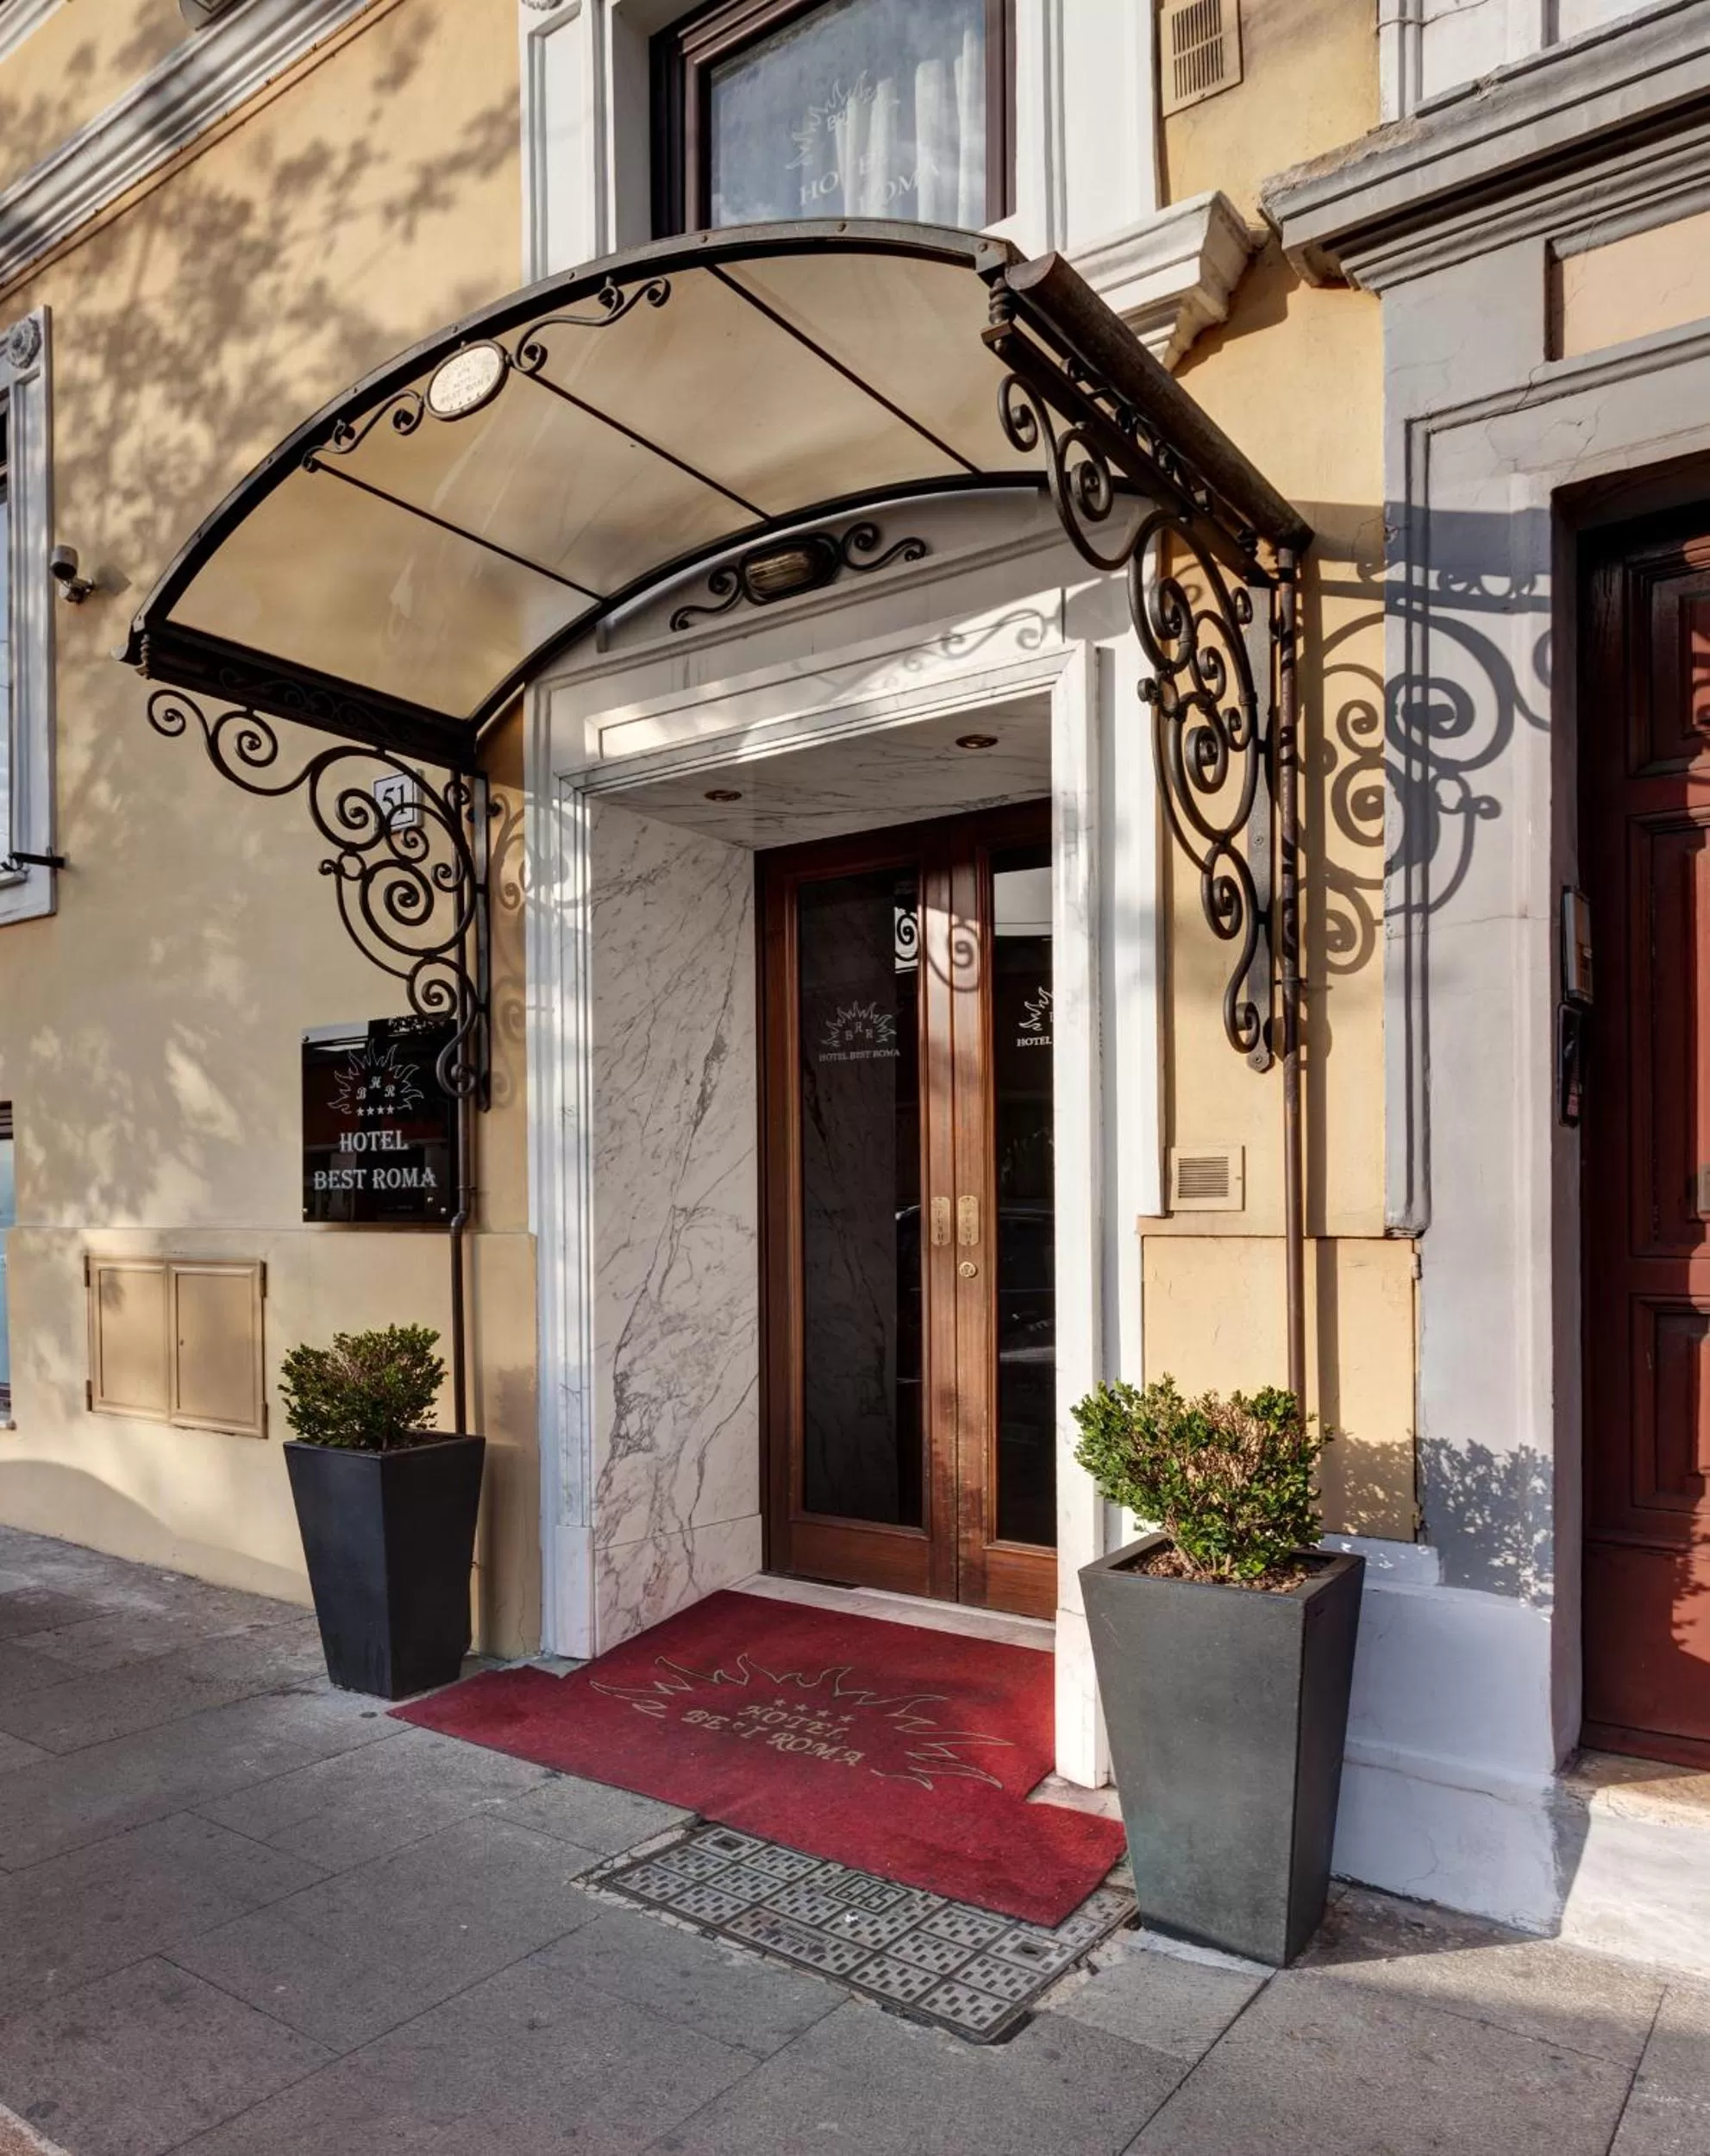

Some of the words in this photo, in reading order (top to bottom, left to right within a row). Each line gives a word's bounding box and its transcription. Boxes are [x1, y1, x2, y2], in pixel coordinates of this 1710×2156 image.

[382, 784, 407, 815] 51
[1016, 1036, 1053, 1047] HOTEL
[819, 1051, 849, 1062] HOTEL
[340, 1130, 410, 1153] HOTEL
[314, 1169, 366, 1190] BEST
[372, 1166, 438, 1189] ROMA
[737, 1705, 850, 1740] HOTEL
[767, 1732, 866, 1766] ROMA
[835, 1878, 899, 1908] GAS
